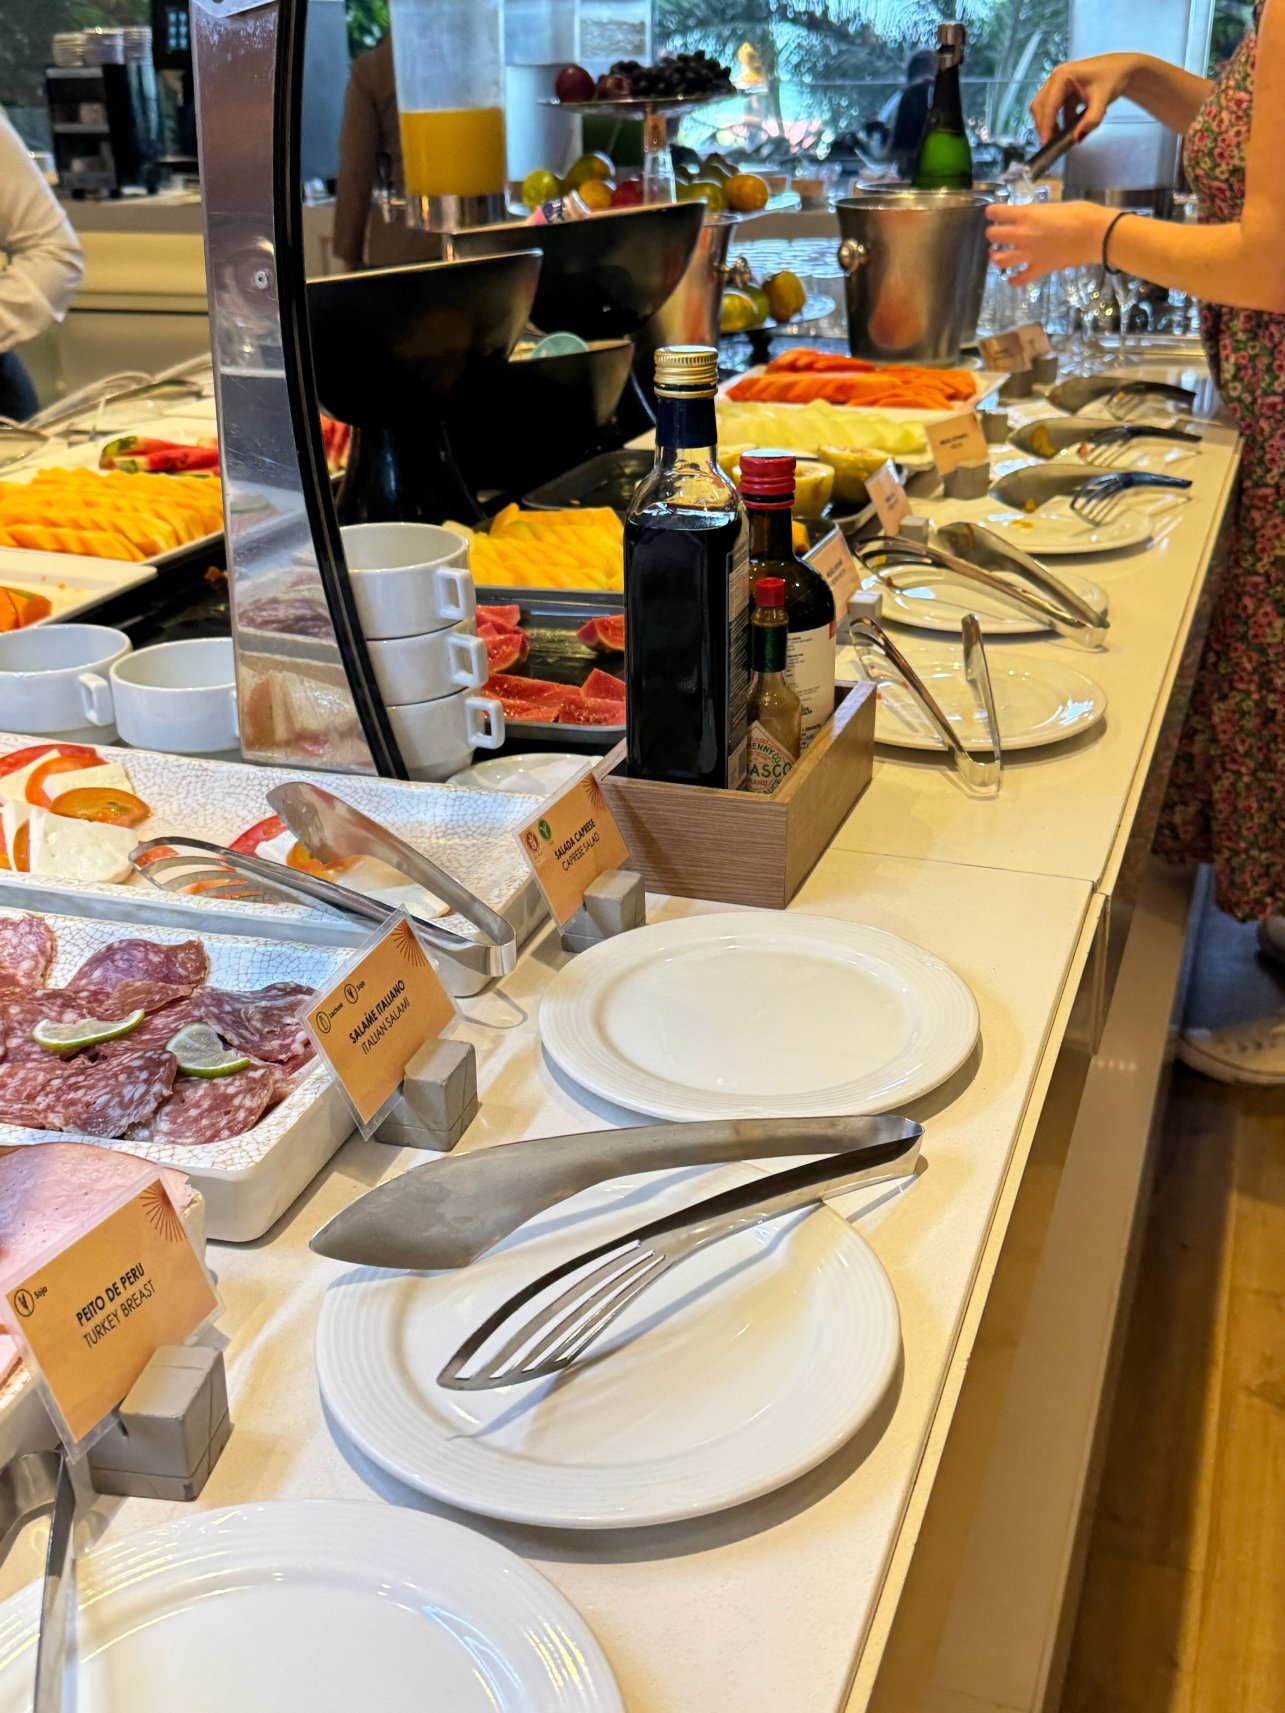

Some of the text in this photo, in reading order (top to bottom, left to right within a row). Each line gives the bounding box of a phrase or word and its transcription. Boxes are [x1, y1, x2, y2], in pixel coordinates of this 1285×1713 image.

[747, 762, 792, 778] ASCO
[554, 837, 576, 861] SALADA
[574, 818, 596, 842] CAPRESE
[562, 845, 585, 871] CAPRESE
[582, 832, 600, 852] SALAD
[375, 979, 405, 1016] ITALIANO
[361, 996, 411, 1055] ITALIAN SALAMI
[34, 1286, 48, 1300] Soja
[76, 1262, 145, 1327] PEITO DE PERU
[83, 1279, 156, 1349] TURKEY BREAST
